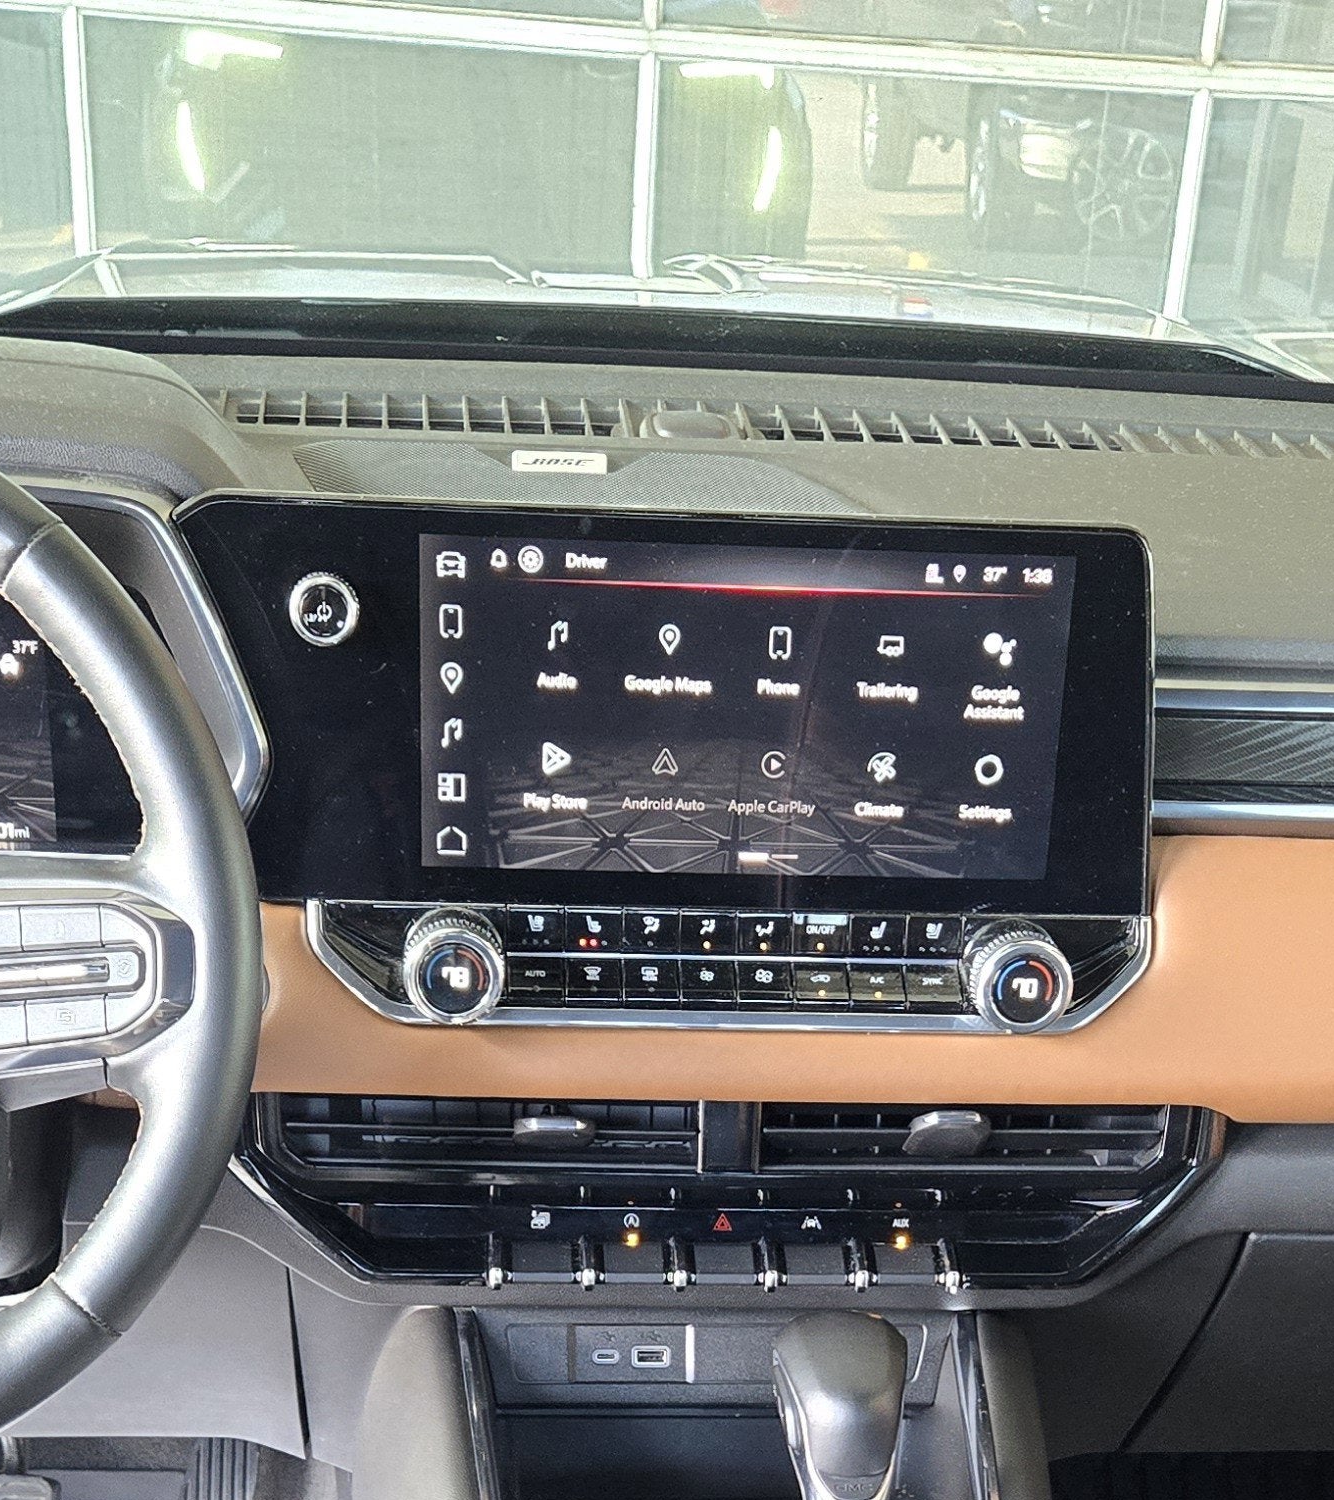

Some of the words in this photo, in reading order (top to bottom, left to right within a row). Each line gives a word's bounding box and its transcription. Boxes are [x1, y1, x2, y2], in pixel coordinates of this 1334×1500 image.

[566, 553, 608, 570] Driver
[536, 671, 579, 690] Audio
[624, 674, 673, 695] Google
[675, 675, 712, 696] Maps
[757, 678, 800, 696] Phone
[856, 681, 918, 702] Trailering
[971, 684, 1020, 704] Google
[963, 704, 1024, 721] Assistant
[523, 792, 551, 812] Play
[552, 794, 588, 810] Store
[622, 796, 673, 811] Android
[675, 798, 705, 812] Auto
[728, 799, 765, 816] Apple
[768, 799, 816, 817] CarPlay
[854, 801, 904, 818] Climate
[958, 804, 1012, 824] Settings
[805, 924, 837, 935] ON/OFF
[442, 966, 470, 989] 78
[524, 969, 547, 979] AUTO
[869, 975, 885, 985] A/C
[921, 976, 945, 986] SYNC
[1011, 977, 1039, 999] 70
[892, 1218, 910, 1228] AUX
